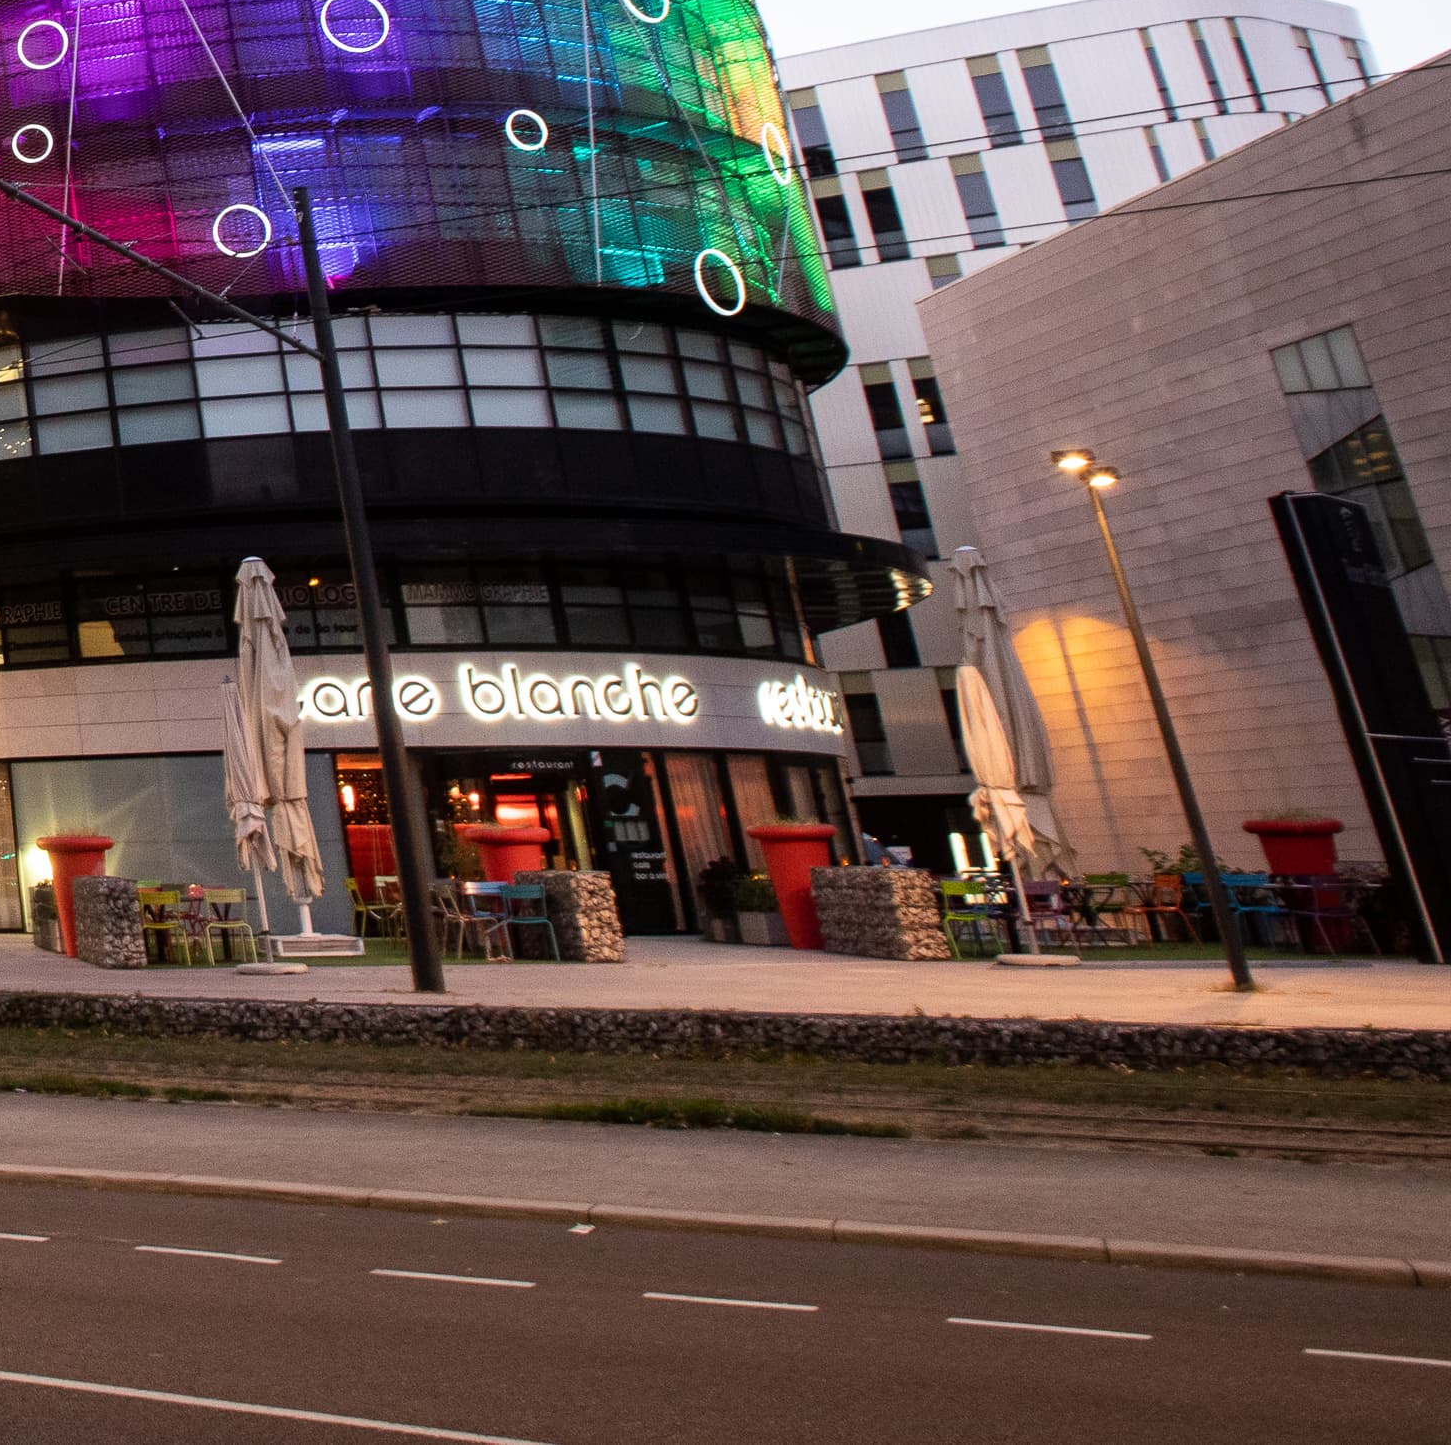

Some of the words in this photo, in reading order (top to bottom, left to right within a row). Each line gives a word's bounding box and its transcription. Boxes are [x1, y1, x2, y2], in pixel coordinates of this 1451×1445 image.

[105, 592, 186, 615] CENTRE
[194, 590, 222, 610] DE
[297, 677, 440, 721] are
[461, 662, 700, 722] blanche
[511, 760, 574, 770] restaurant
